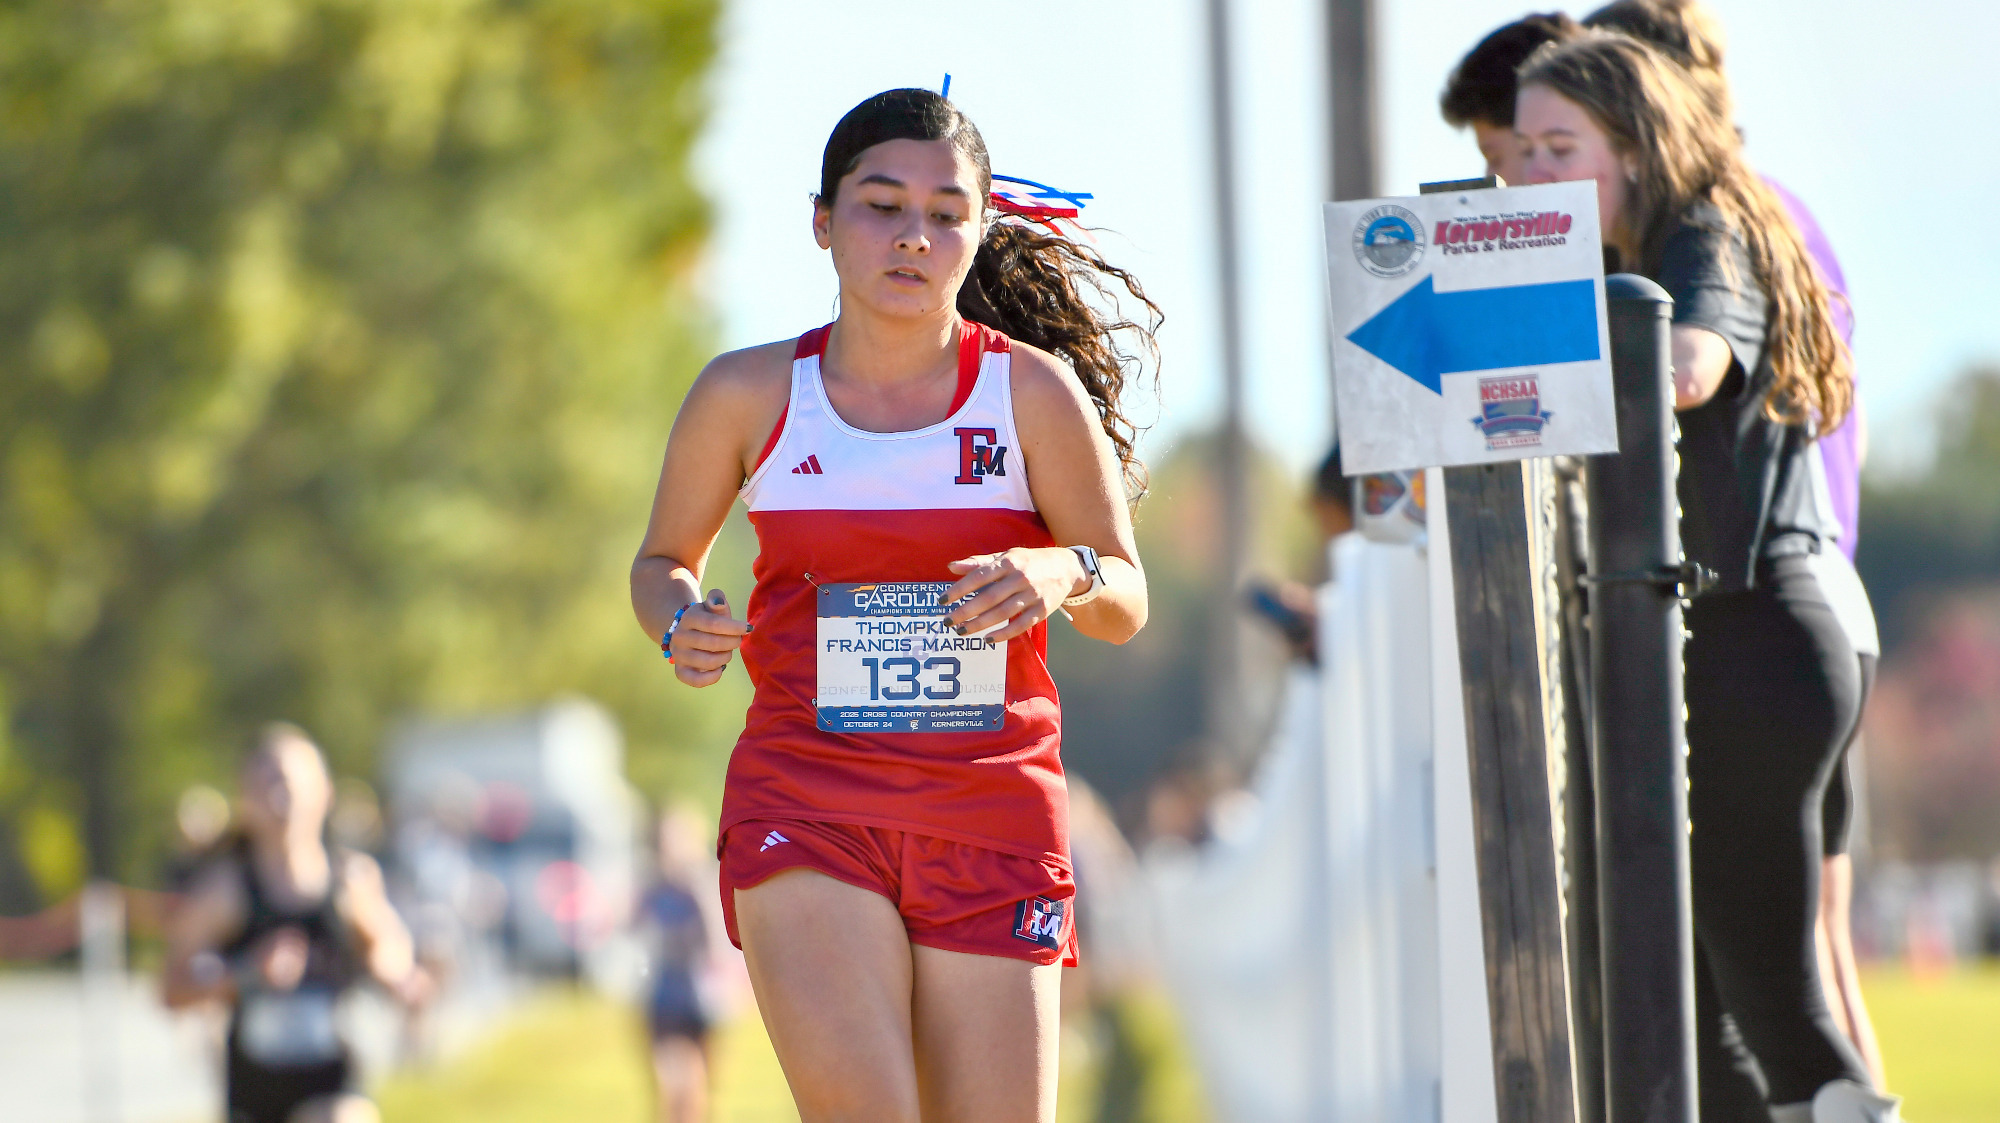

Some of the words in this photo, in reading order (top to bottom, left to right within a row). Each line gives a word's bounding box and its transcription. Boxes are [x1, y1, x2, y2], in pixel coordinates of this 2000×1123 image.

[1433, 211, 1572, 245] Kernersville
[1443, 243, 1478, 255] Parks
[1482, 241, 1494, 251] &
[1499, 235, 1566, 251] Recreation
[1481, 380, 1538, 400] NCHSAA
[954, 428, 1007, 484] FM
[880, 583, 953, 592] CONFERENC
[827, 638, 912, 652] FRANCIS
[923, 637, 996, 651] MARION
[862, 656, 961, 700] 133
[930, 710, 983, 718] CHAMPIONSHIP
[931, 720, 984, 728] KERNERSVILLE
